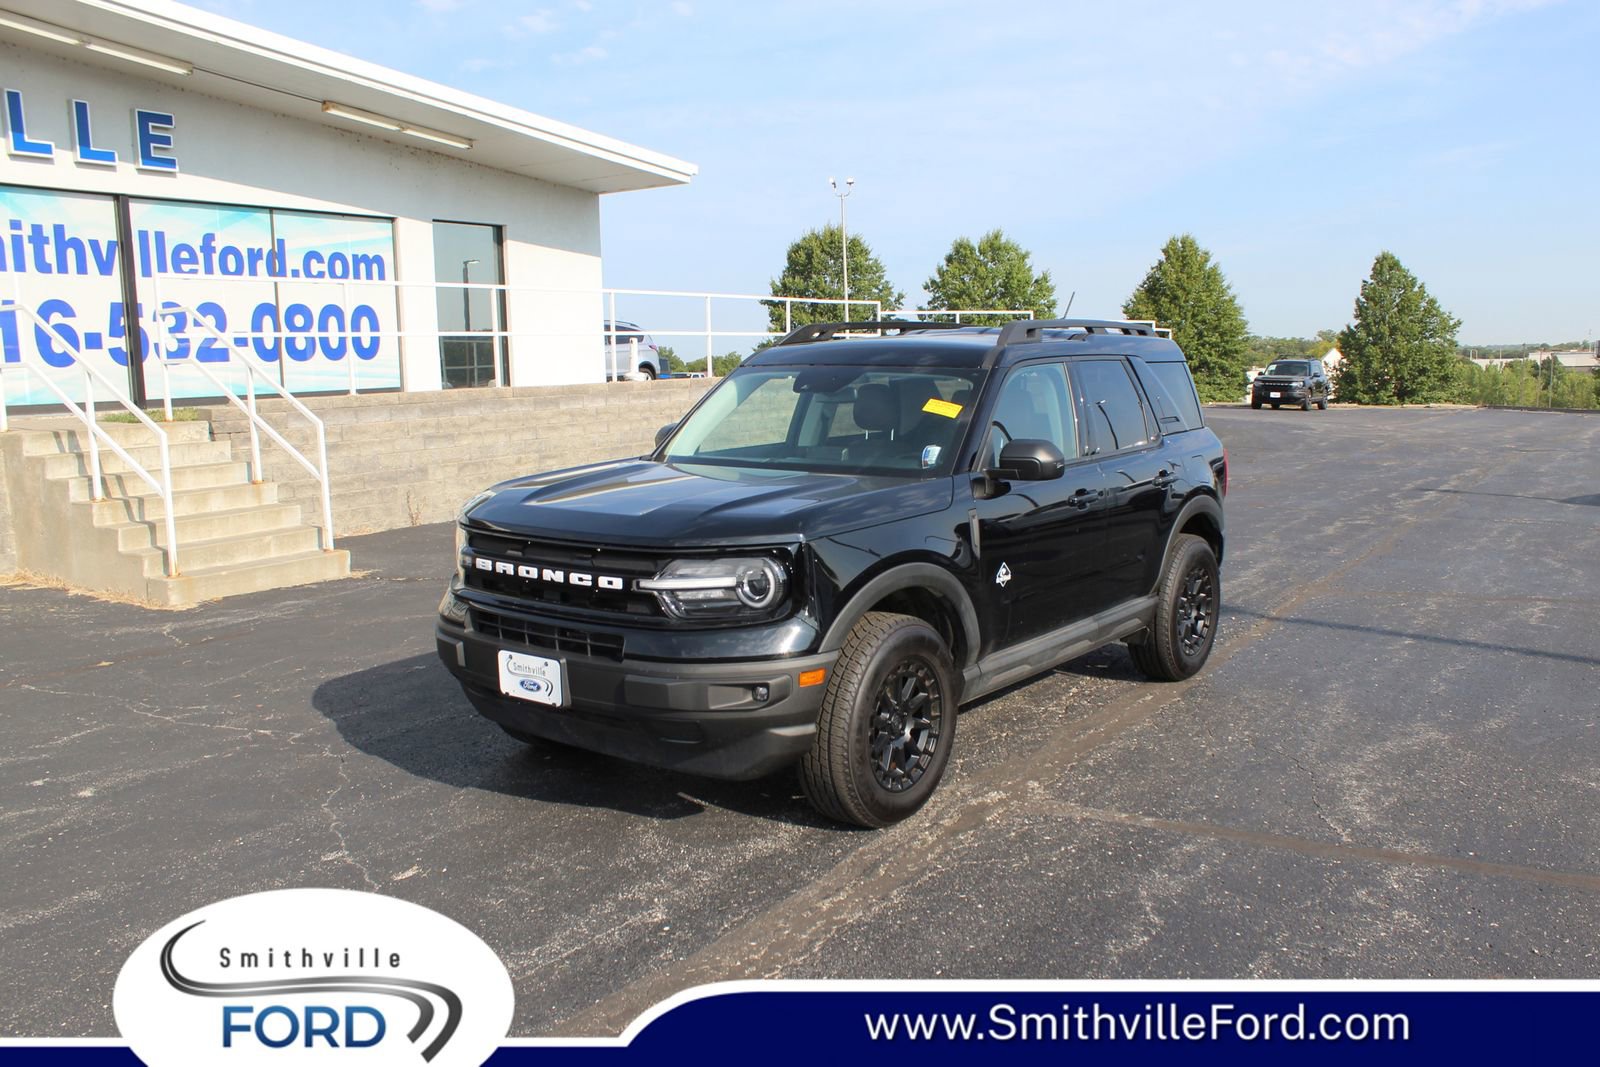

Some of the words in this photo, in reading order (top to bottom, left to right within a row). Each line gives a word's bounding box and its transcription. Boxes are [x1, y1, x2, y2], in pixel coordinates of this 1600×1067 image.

[4, 87, 179, 173] LLE
[0, 219, 386, 281] ithvlleford.com
[475, 557, 624, 590] BRONCO
[513, 661, 546, 677] Smithville
